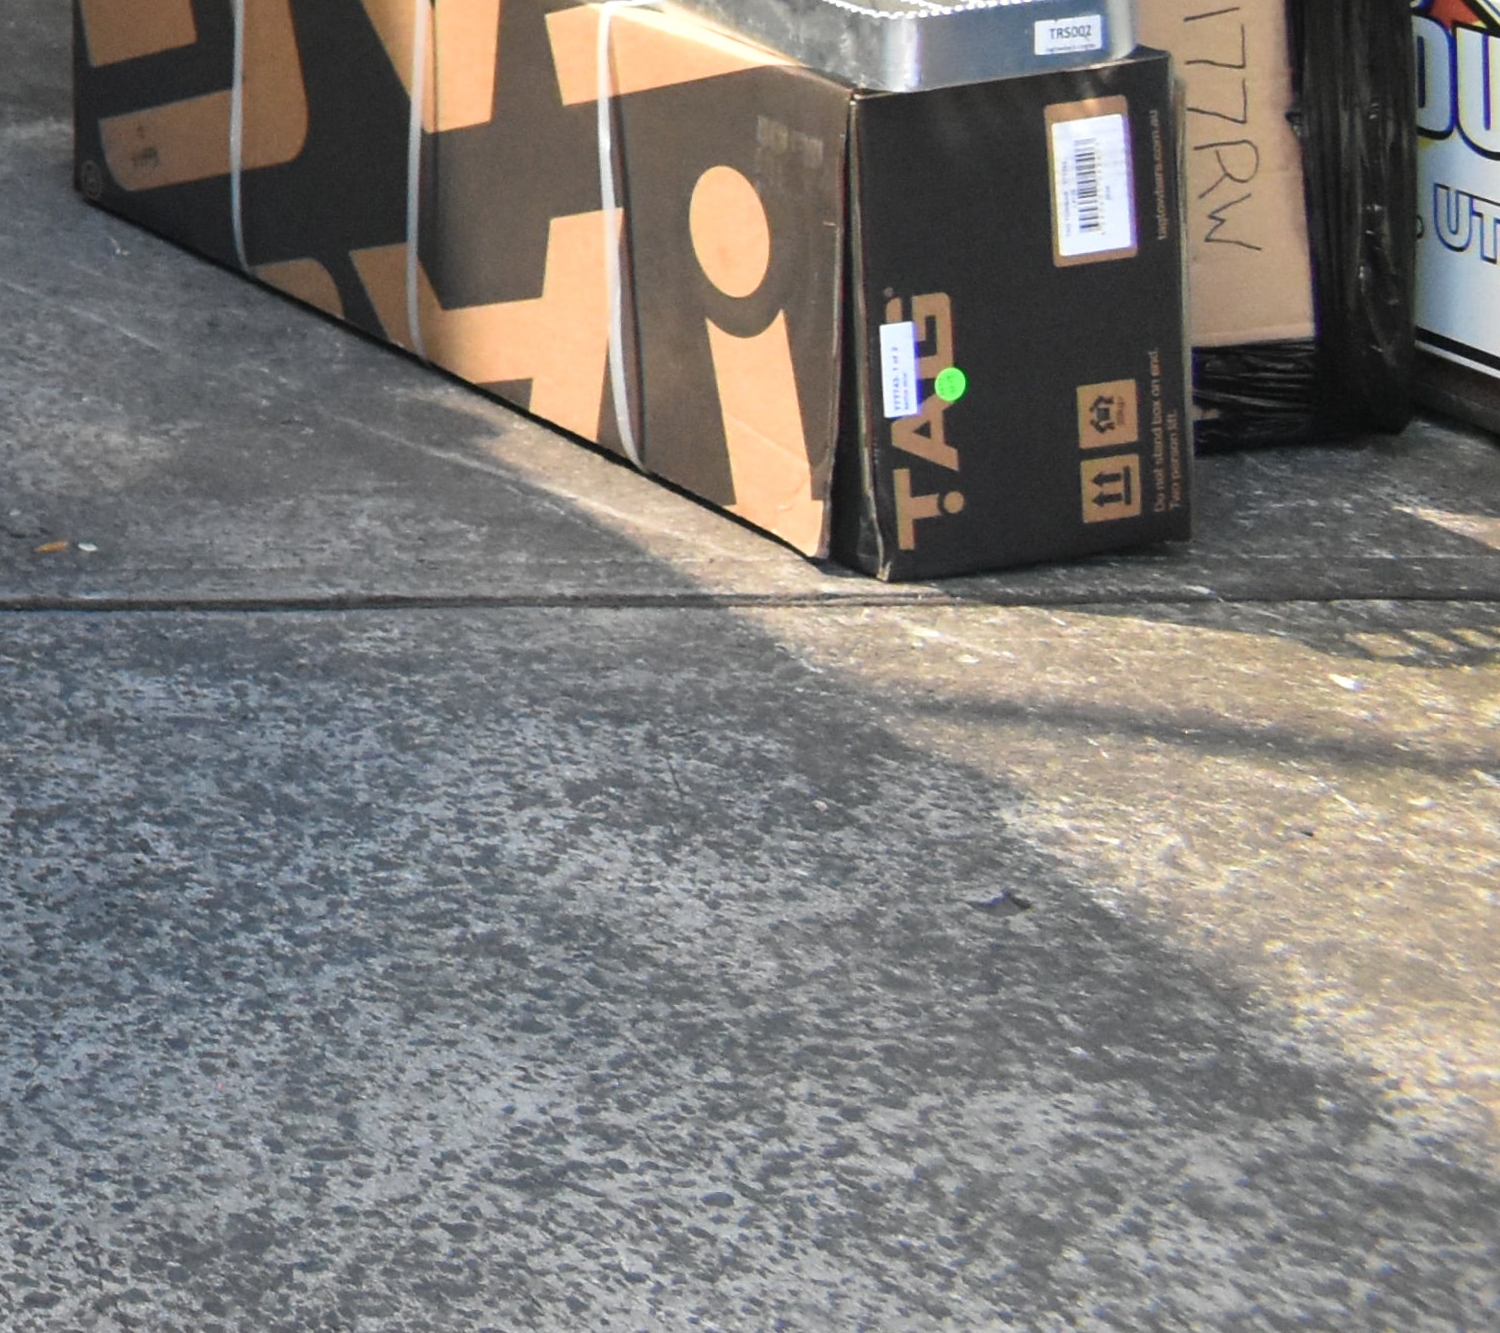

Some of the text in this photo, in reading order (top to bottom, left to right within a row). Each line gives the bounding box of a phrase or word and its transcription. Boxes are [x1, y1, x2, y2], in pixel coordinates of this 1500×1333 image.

[1049, 24, 1092, 40] TRS002
[1151, 379, 1161, 397] on
[884, 290, 966, 552] TAG
[1150, 399, 1162, 425] box
[1151, 427, 1164, 465] stand
[1168, 433, 1182, 479] person
[1153, 469, 1165, 490] not
[1153, 494, 1165, 512] Do
[1169, 483, 1181, 509] Two
